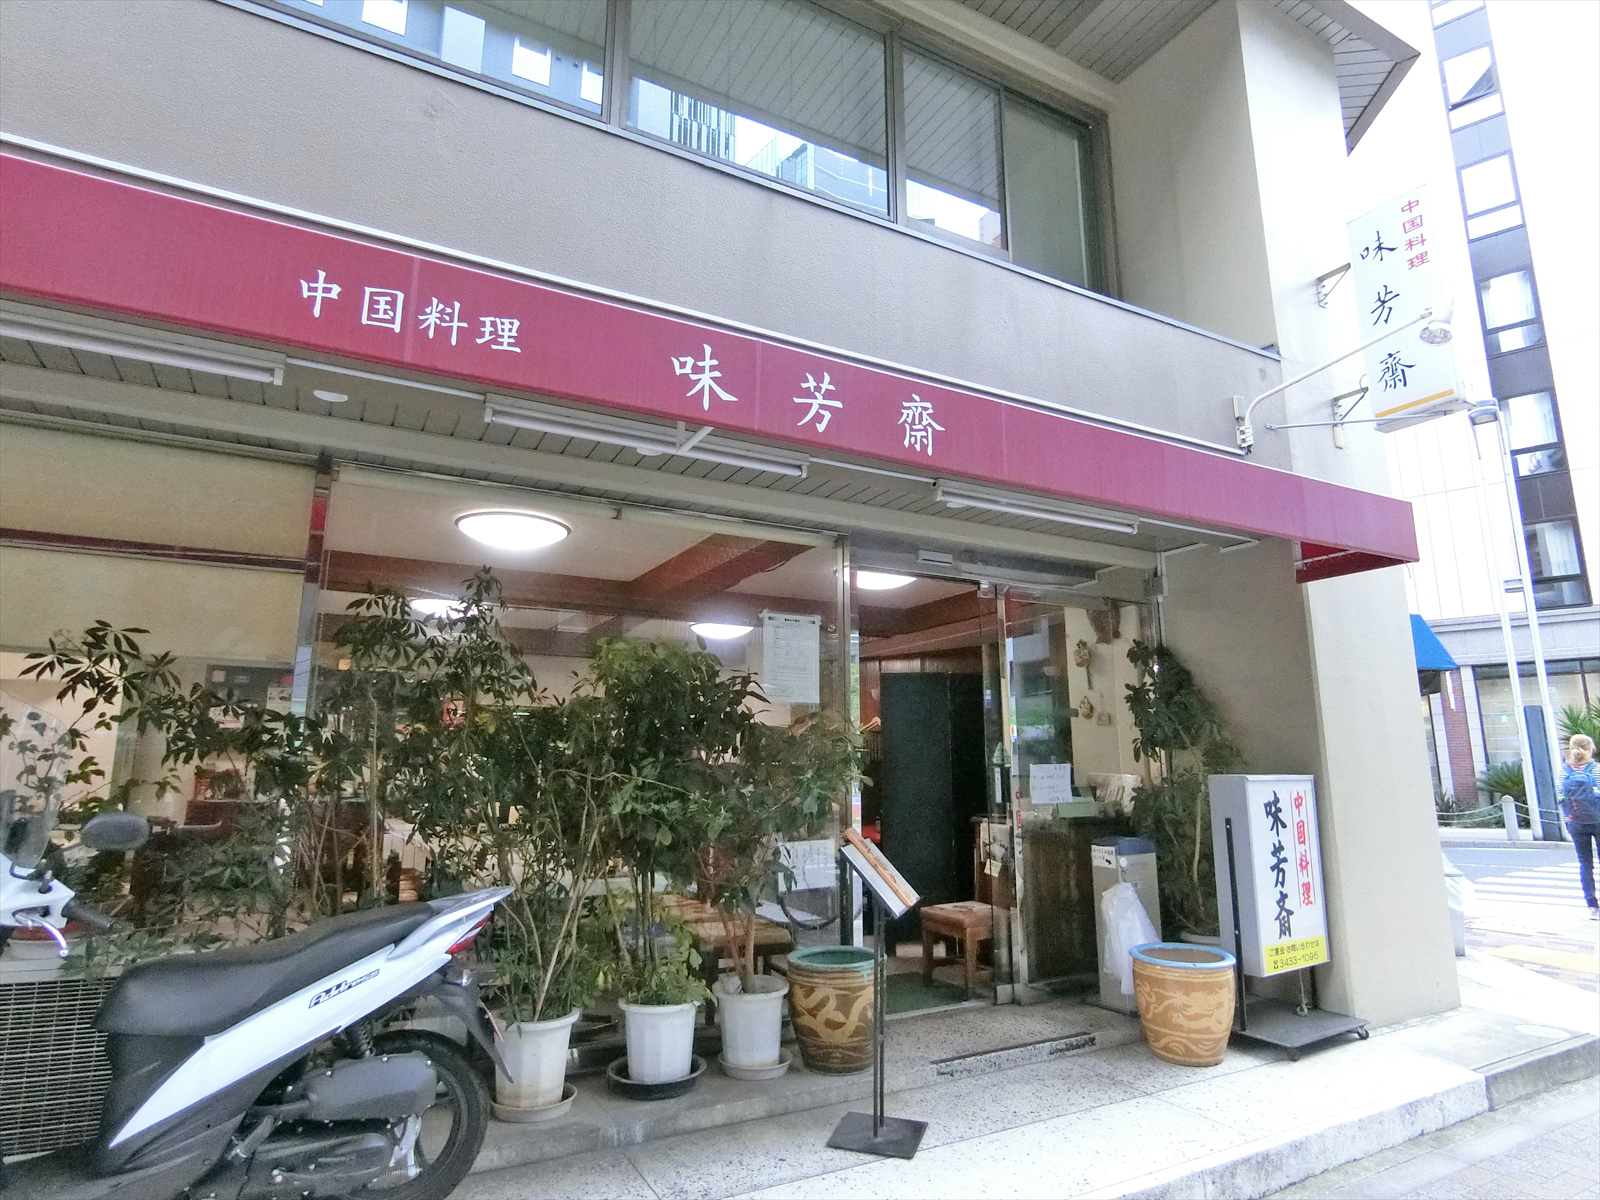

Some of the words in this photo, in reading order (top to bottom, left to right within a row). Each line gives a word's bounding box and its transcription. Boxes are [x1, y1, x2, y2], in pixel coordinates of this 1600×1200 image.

[1400, 199, 1430, 270] 中国料理
[299, 269, 522, 353] 中国料理
[1293, 790, 1313, 906] 中国料理
[1279, 951, 1319, 968] 3433-1095
